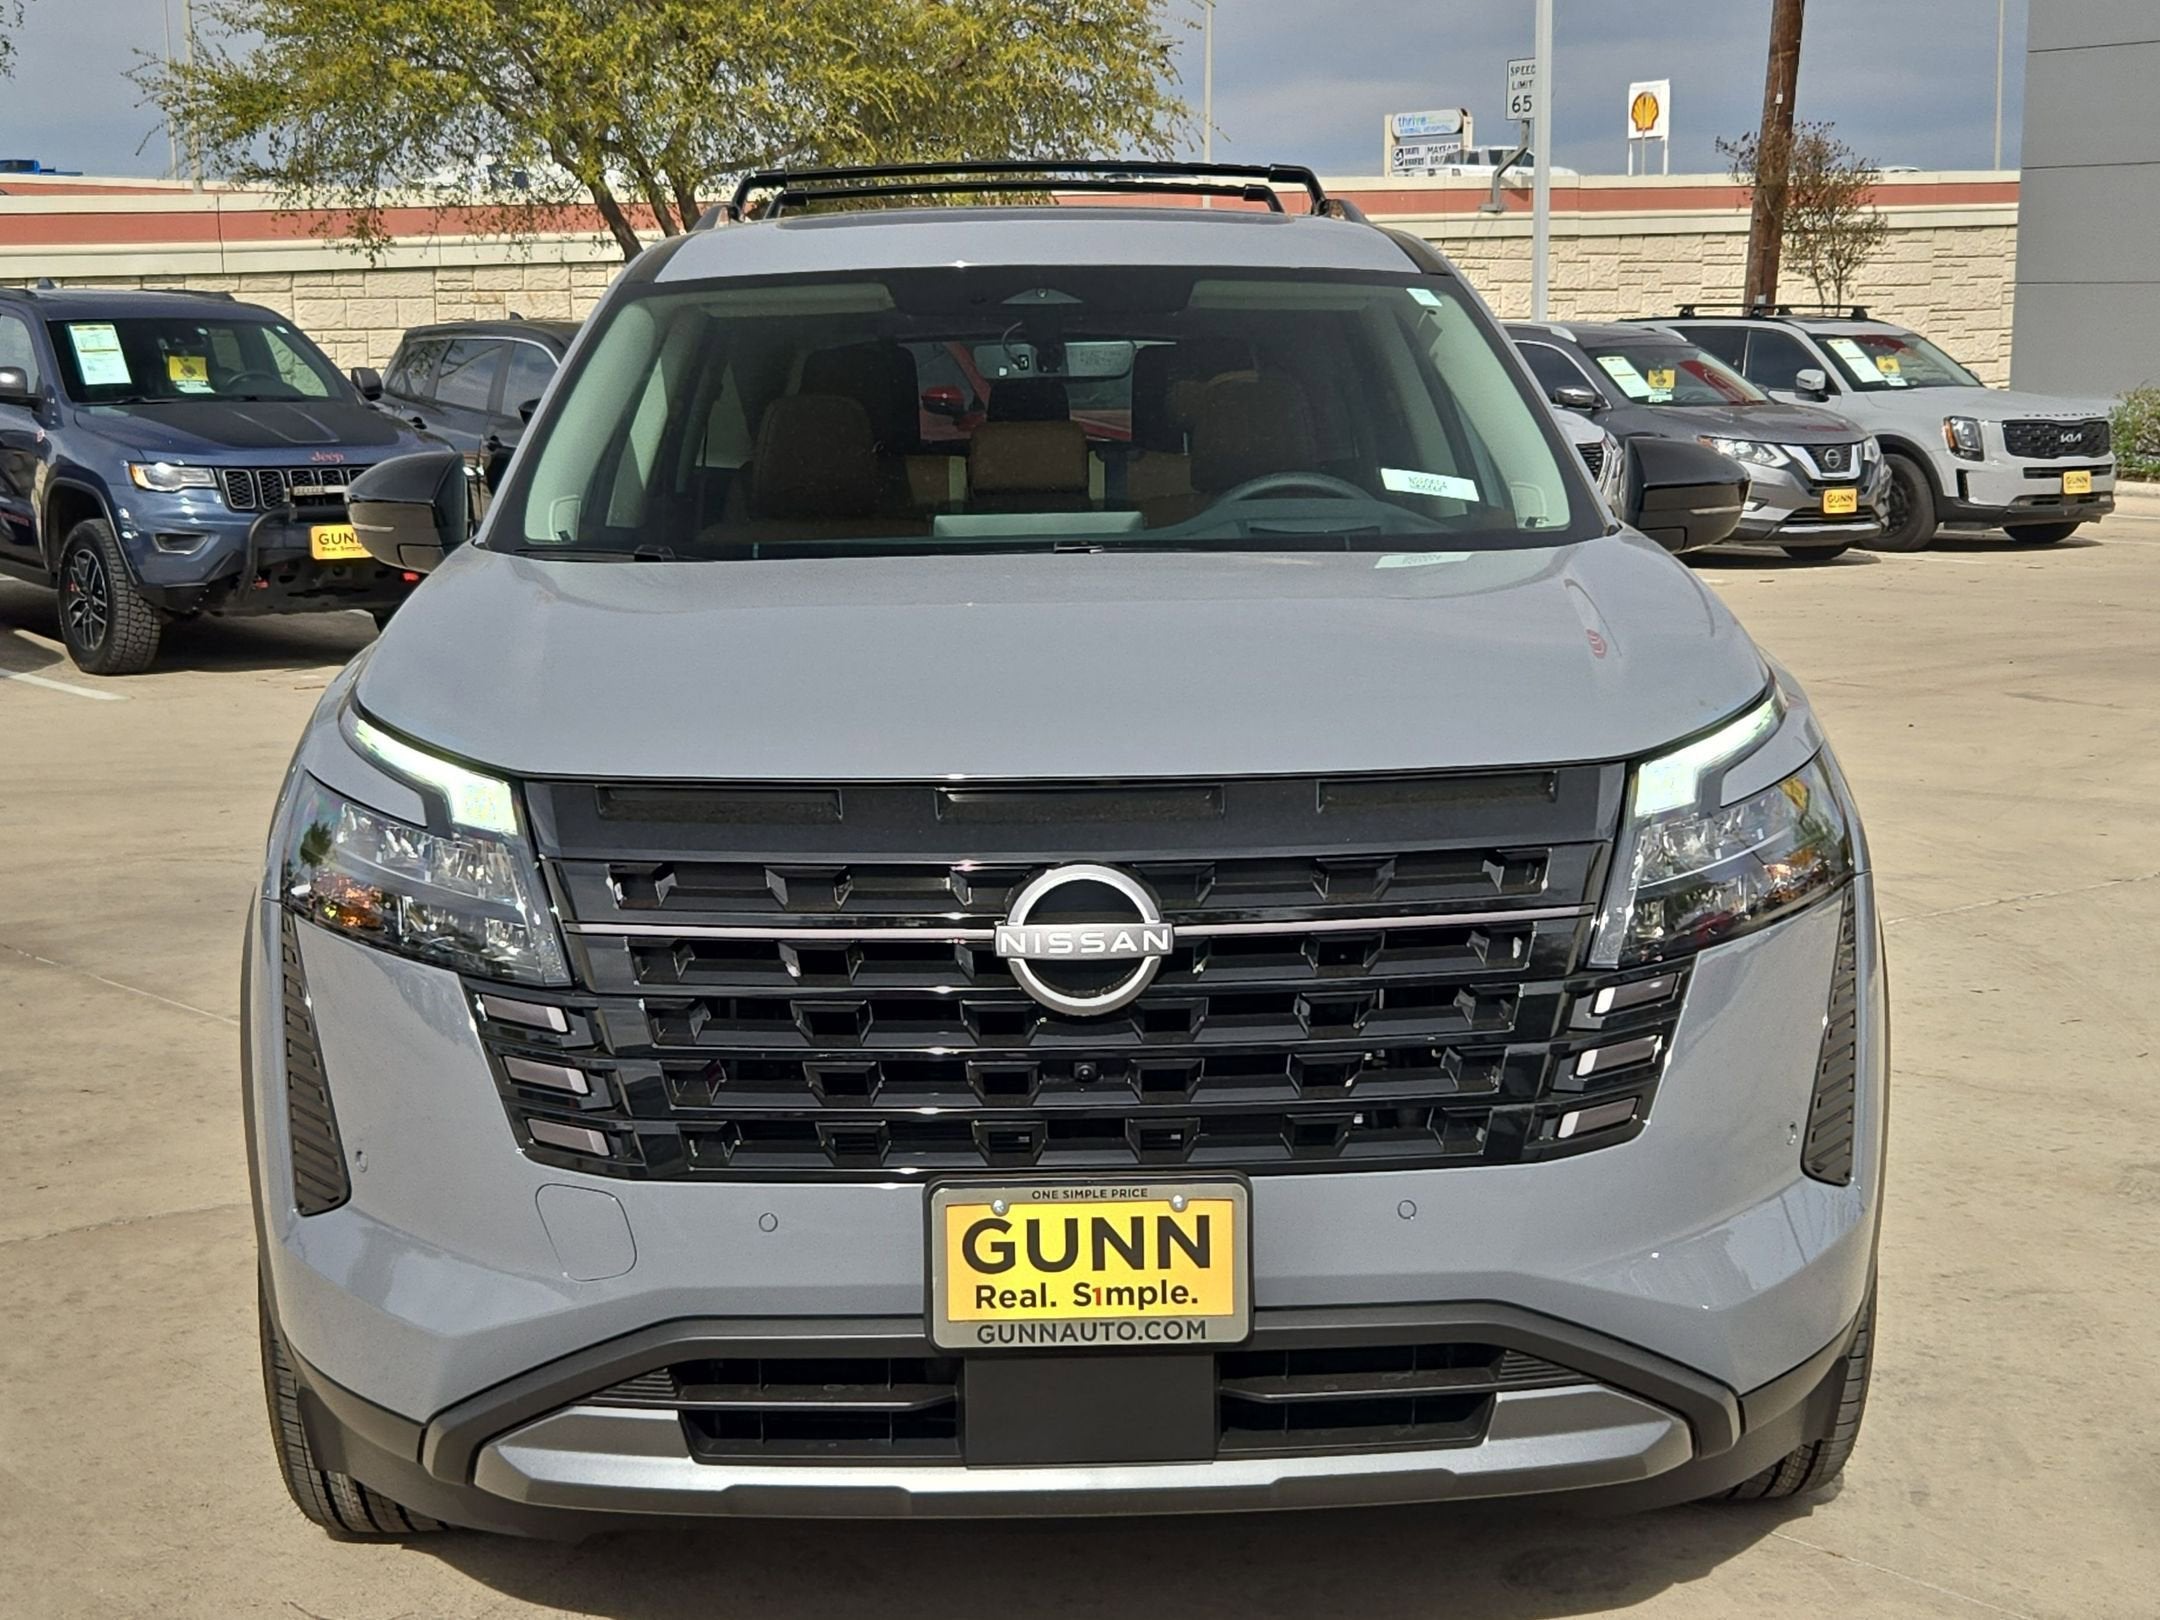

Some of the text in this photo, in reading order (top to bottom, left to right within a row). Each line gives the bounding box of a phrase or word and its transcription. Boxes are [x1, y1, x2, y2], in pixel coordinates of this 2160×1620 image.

[1512, 80, 1534, 90] LIMIT
[1511, 95, 1533, 113] 65
[1398, 115, 1426, 127] thrive
[311, 451, 344, 463] Jeep
[1827, 494, 1854, 504] GUNN
[1000, 929, 1169, 954] NISSAN
[1031, 1188, 1148, 1200] ONE SIMPLE PRICE
[962, 1214, 1211, 1275] GUNN
[975, 1282, 1058, 1309] Real.
[977, 1320, 1207, 1344] GUNNAUTO.COM
